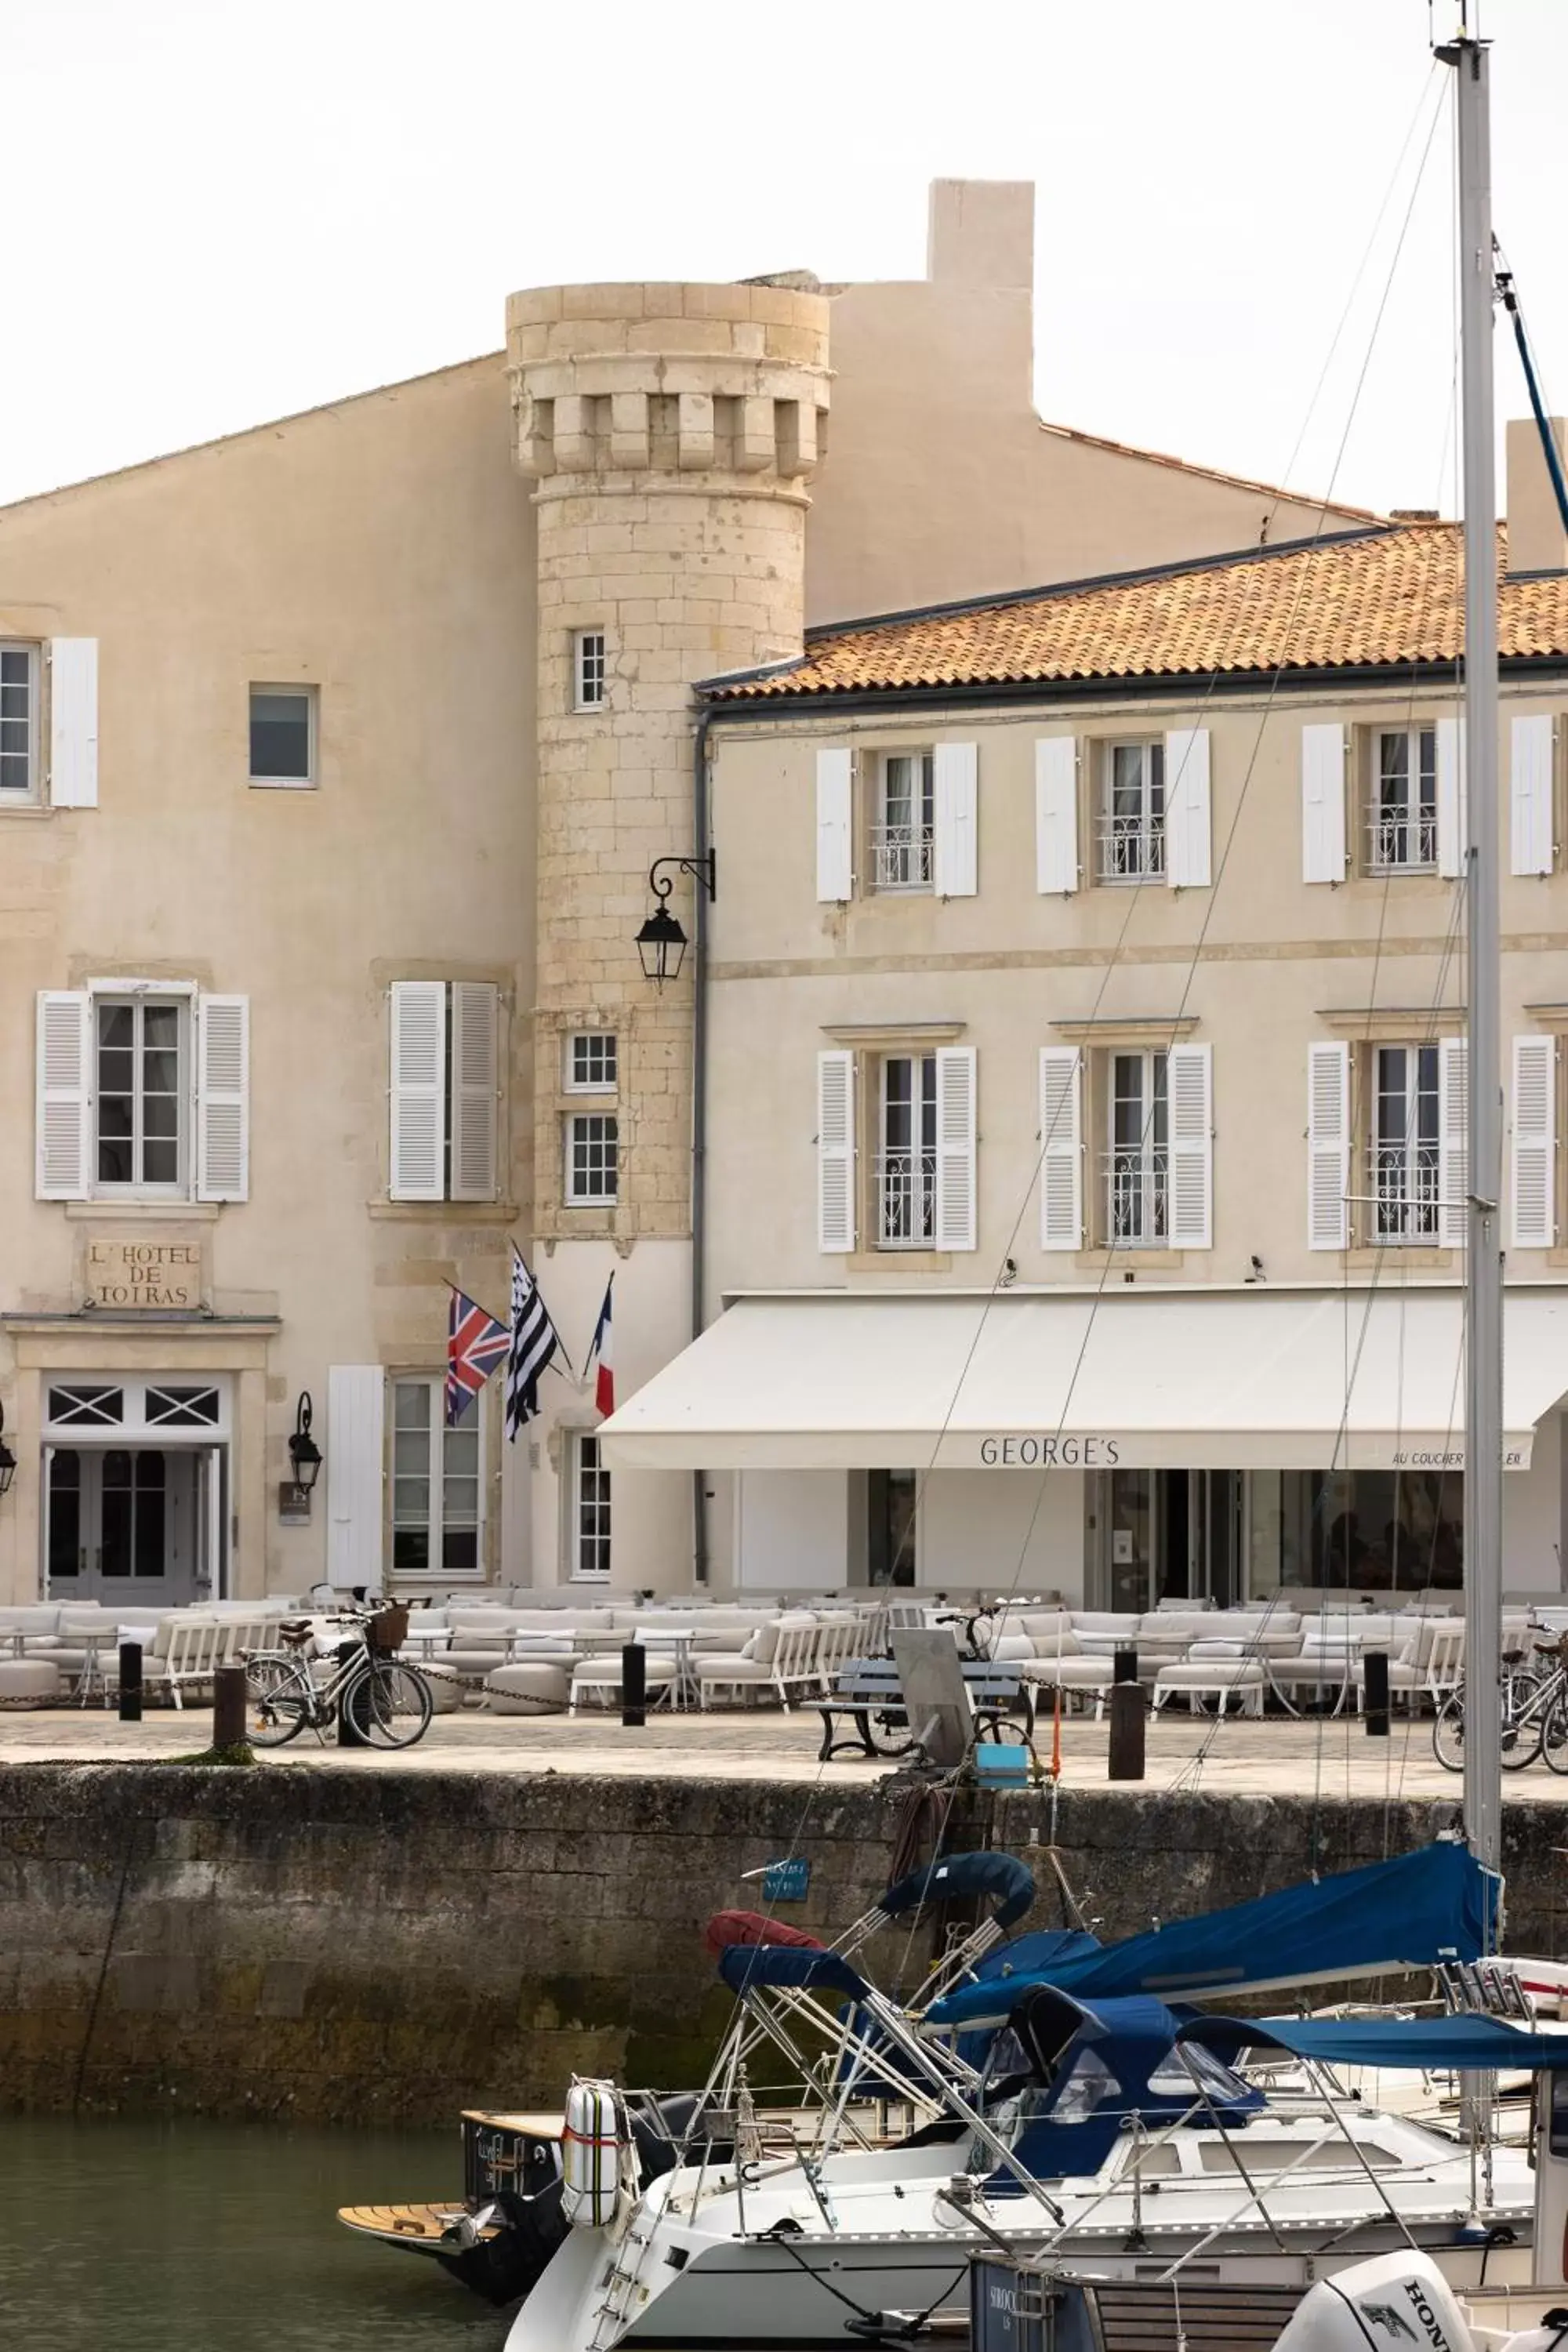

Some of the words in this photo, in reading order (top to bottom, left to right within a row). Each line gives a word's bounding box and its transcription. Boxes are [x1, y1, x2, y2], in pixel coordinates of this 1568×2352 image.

[130, 1266, 161, 1283] DE
[97, 1287, 188, 1305] TOIRAS
[981, 1437, 1120, 1465] GEORGE'S
[1392, 1453, 1408, 1465] AU
[1412, 1452, 1464, 1465] COUCHER
[1403, 2279, 1450, 2352] HON
